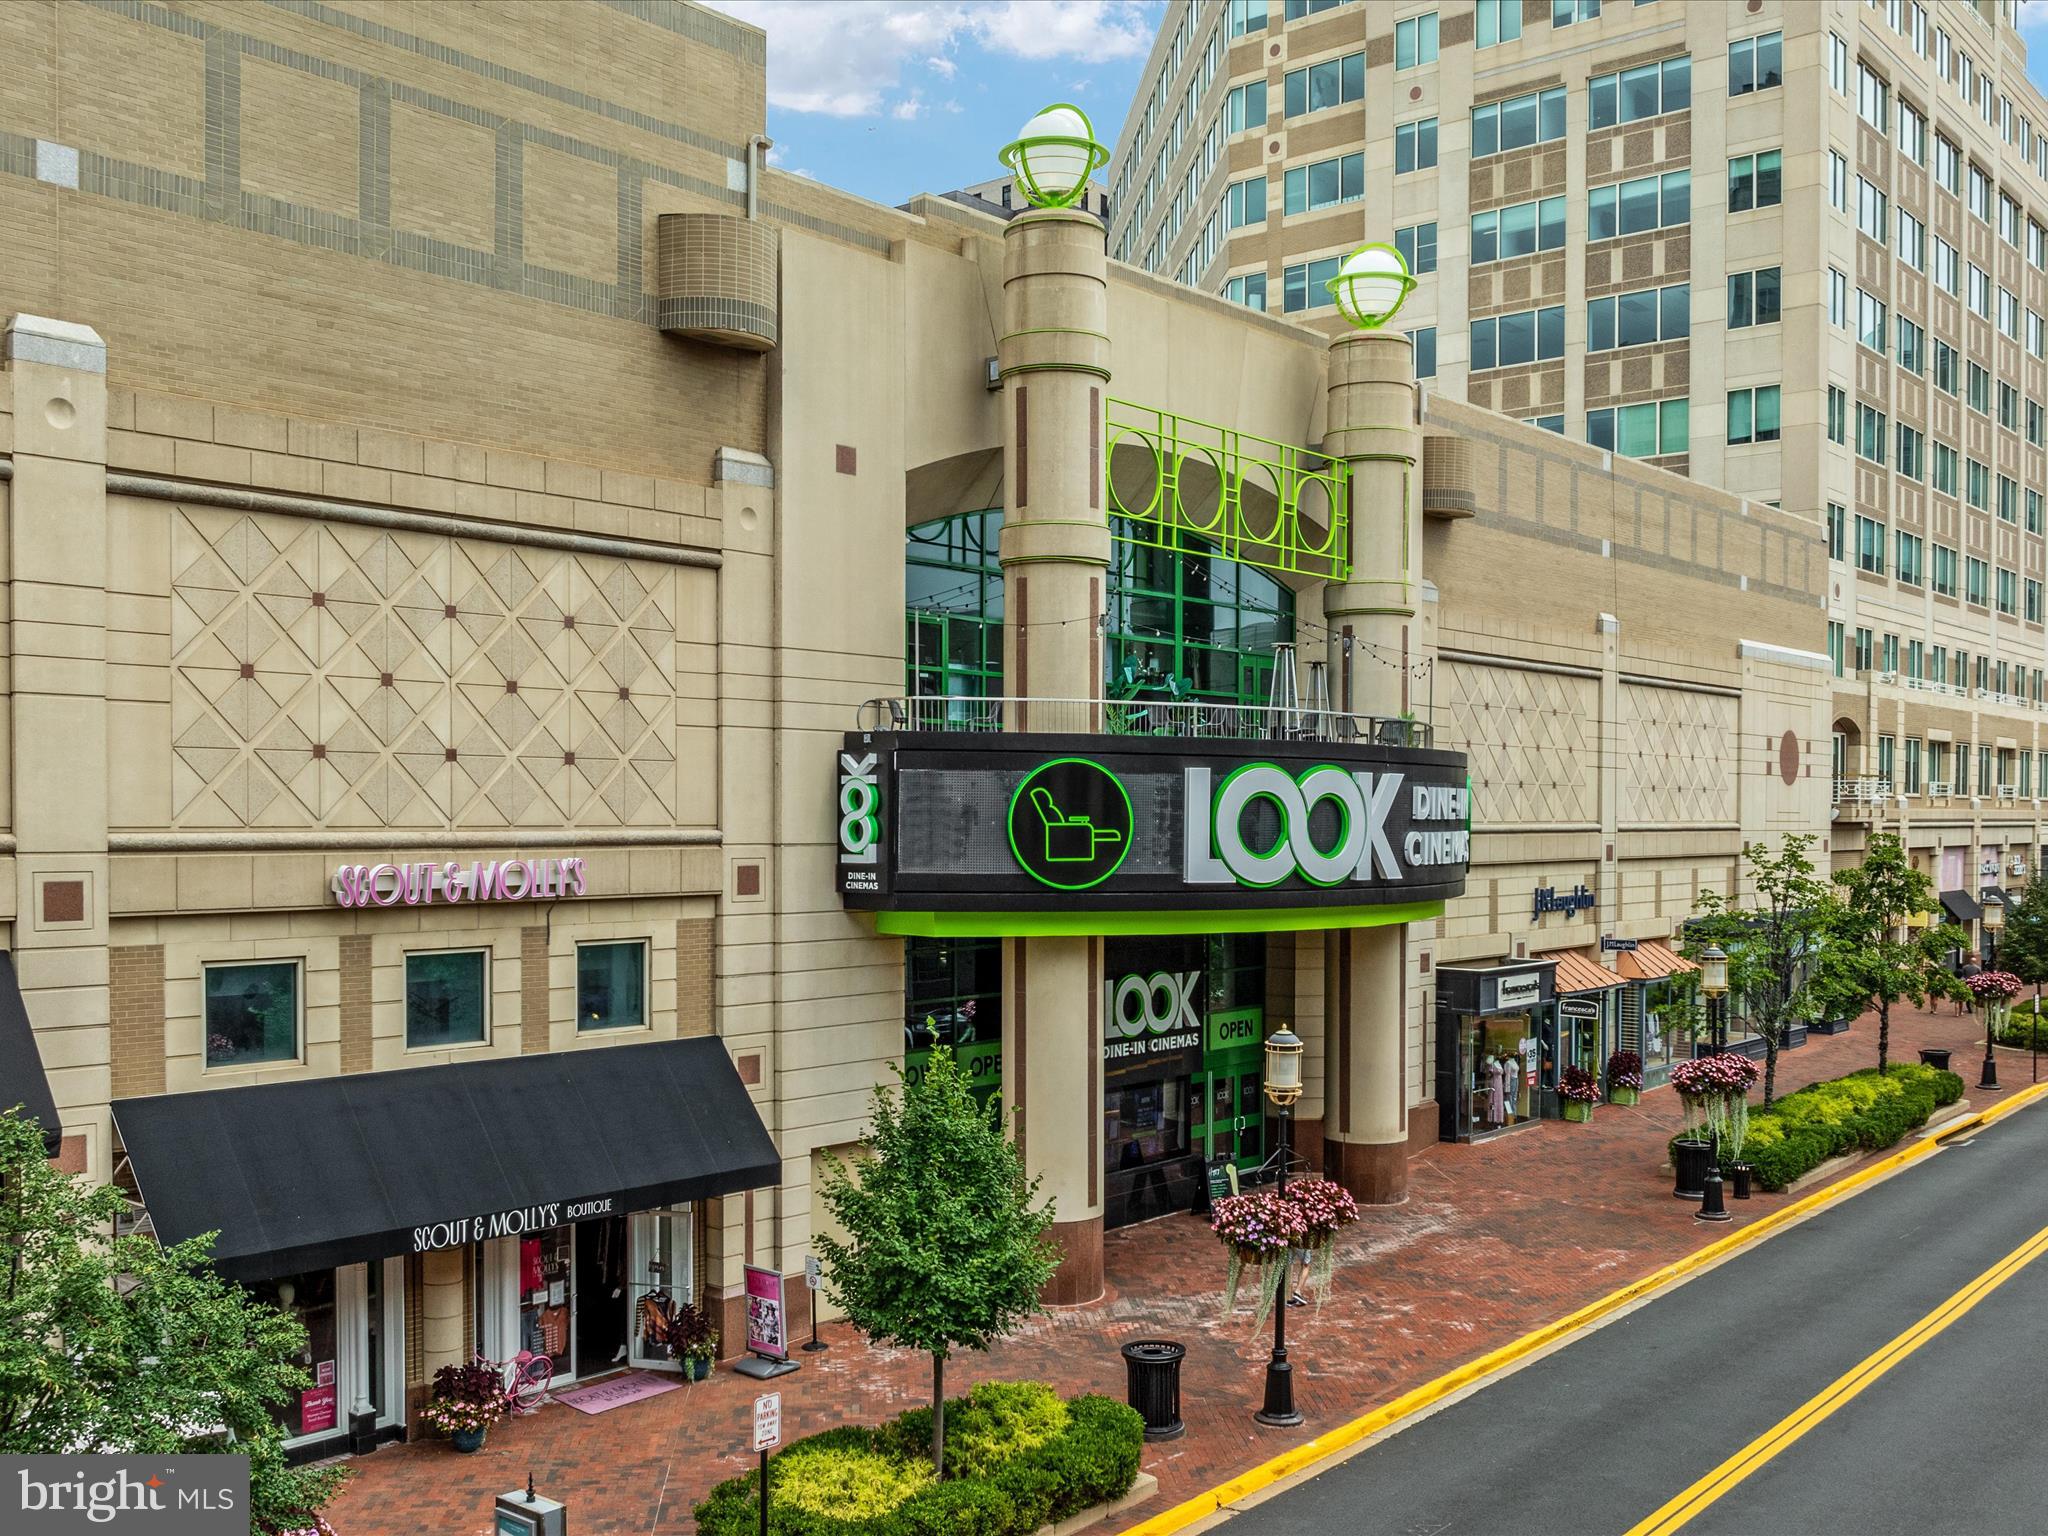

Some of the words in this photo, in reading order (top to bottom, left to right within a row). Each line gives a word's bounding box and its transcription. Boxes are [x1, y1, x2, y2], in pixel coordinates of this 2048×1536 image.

[840, 753, 878, 863] LOOK
[1183, 762, 1404, 888] LOOK
[336, 864, 438, 908] SCOUT
[441, 862, 463, 902] &
[468, 858, 586, 900] MOLLY'S
[845, 881, 879, 890] CINEMAS
[847, 872, 876, 880] DINE-IN
[1104, 971, 1201, 1039] LOOK
[1219, 1018, 1254, 1041] OPEN
[1104, 1040, 1146, 1059] DINE-IN
[1151, 1033, 1199, 1051] CINEMAS
[970, 1055, 1002, 1078] OPE
[414, 1218, 470, 1252] SCOUT
[474, 1216, 484, 1241] &
[488, 1204, 558, 1239] MOLLY'S
[567, 1199, 612, 1218] BOUTIQUE
[757, 1408, 778, 1421] PARKING
[763, 1400, 773, 1410] NO
